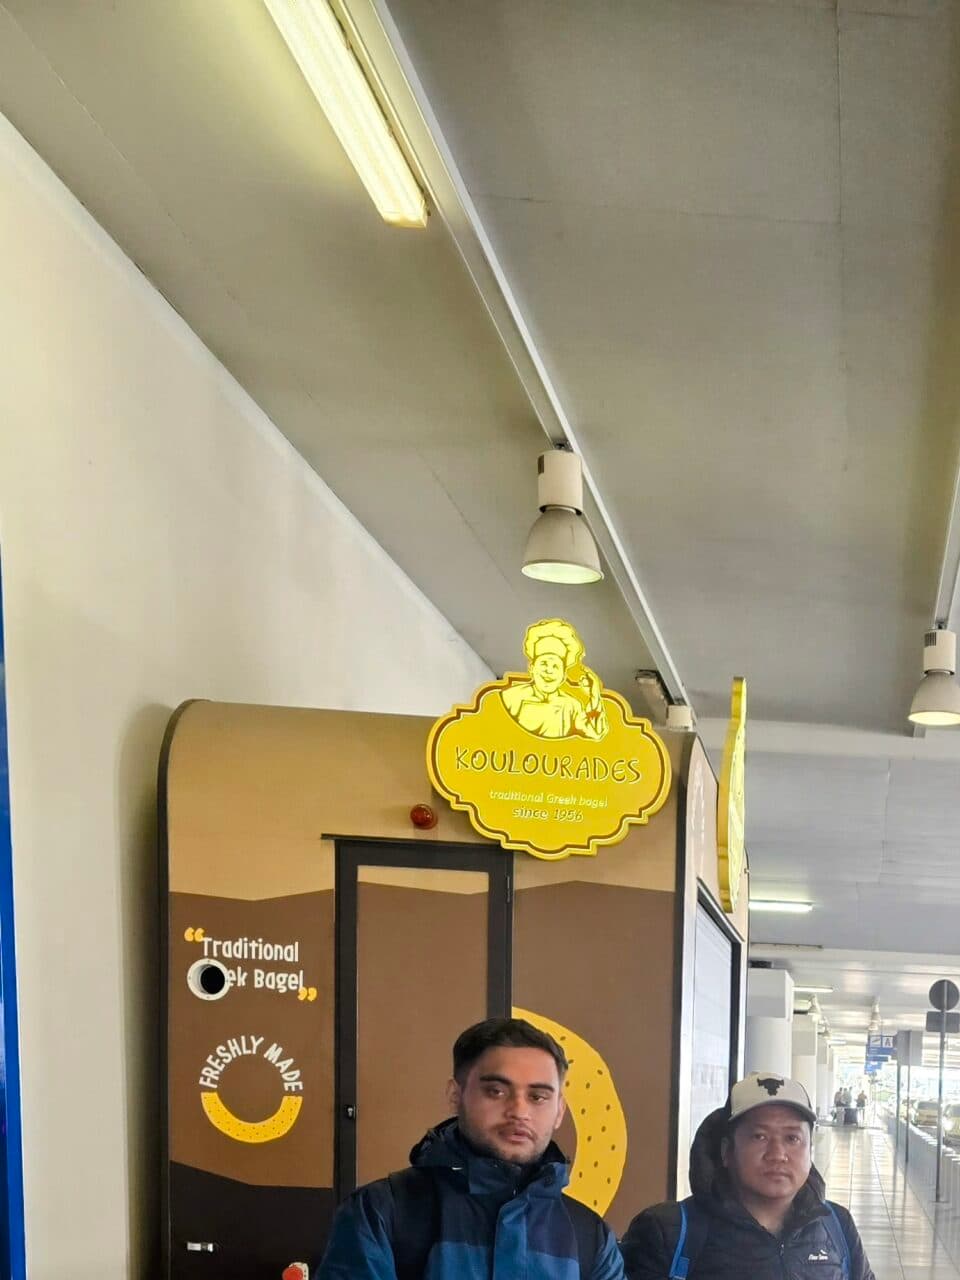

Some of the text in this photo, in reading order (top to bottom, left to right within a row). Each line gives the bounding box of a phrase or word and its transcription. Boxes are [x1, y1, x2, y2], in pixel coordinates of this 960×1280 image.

[455, 745, 642, 784] KOULOURADES
[488, 789, 544, 803] traditional
[579, 796, 608, 808] bagel
[512, 805, 549, 819] since
[198, 1035, 304, 1092] FRESHLY MADE
